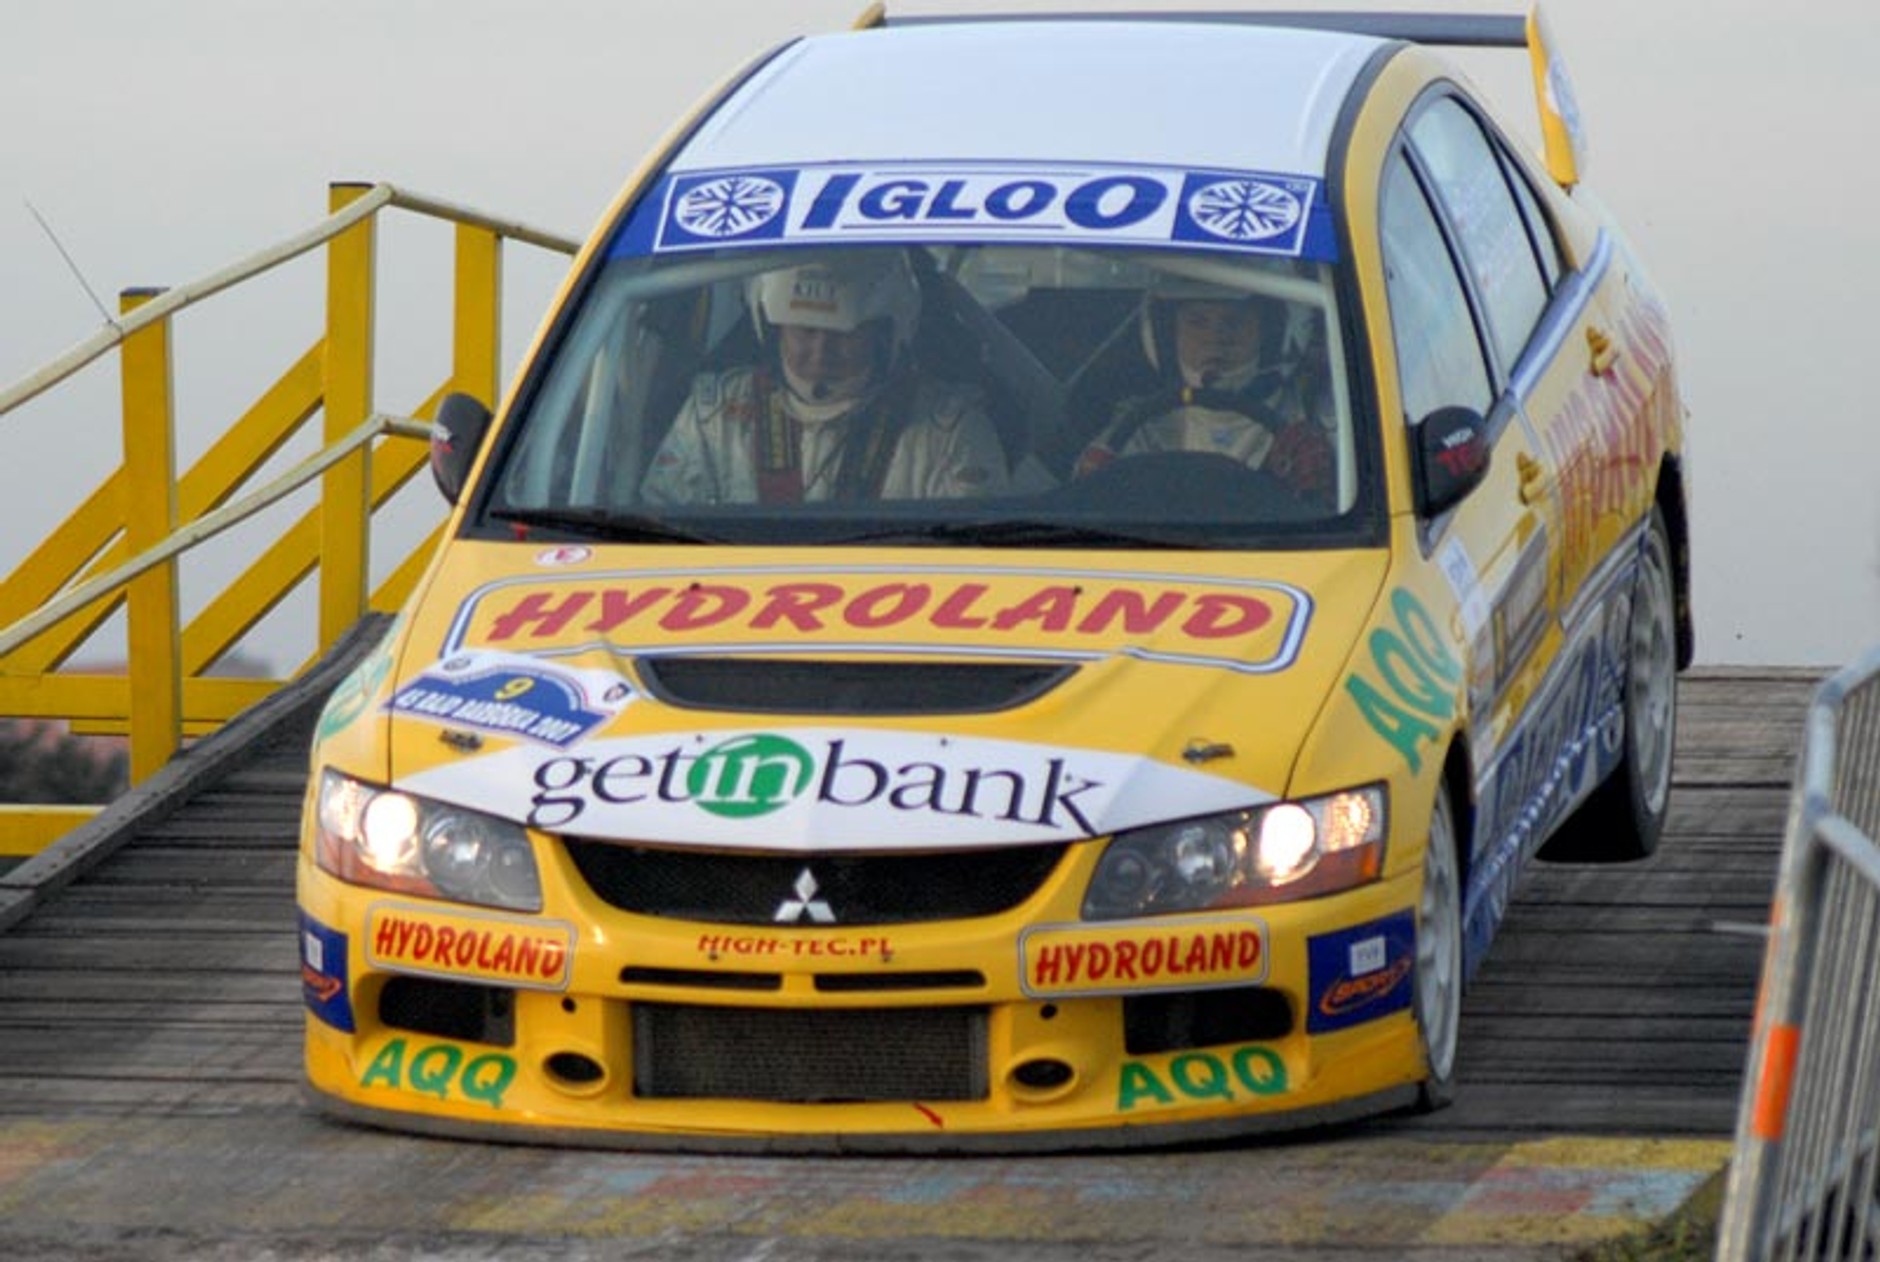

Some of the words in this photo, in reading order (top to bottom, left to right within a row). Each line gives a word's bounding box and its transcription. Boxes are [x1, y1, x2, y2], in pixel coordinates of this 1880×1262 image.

[800, 172, 1169, 230] IGLOO
[486, 583, 1272, 641] HYDROLAND
[494, 676, 535, 701] 9
[1345, 585, 1463, 776] AQQ
[376, 917, 565, 979] HYDROLAND
[1035, 930, 1262, 986] HYDROLAND
[360, 1039, 517, 1107] AQQ
[1118, 1047, 1288, 1110] AQQ
